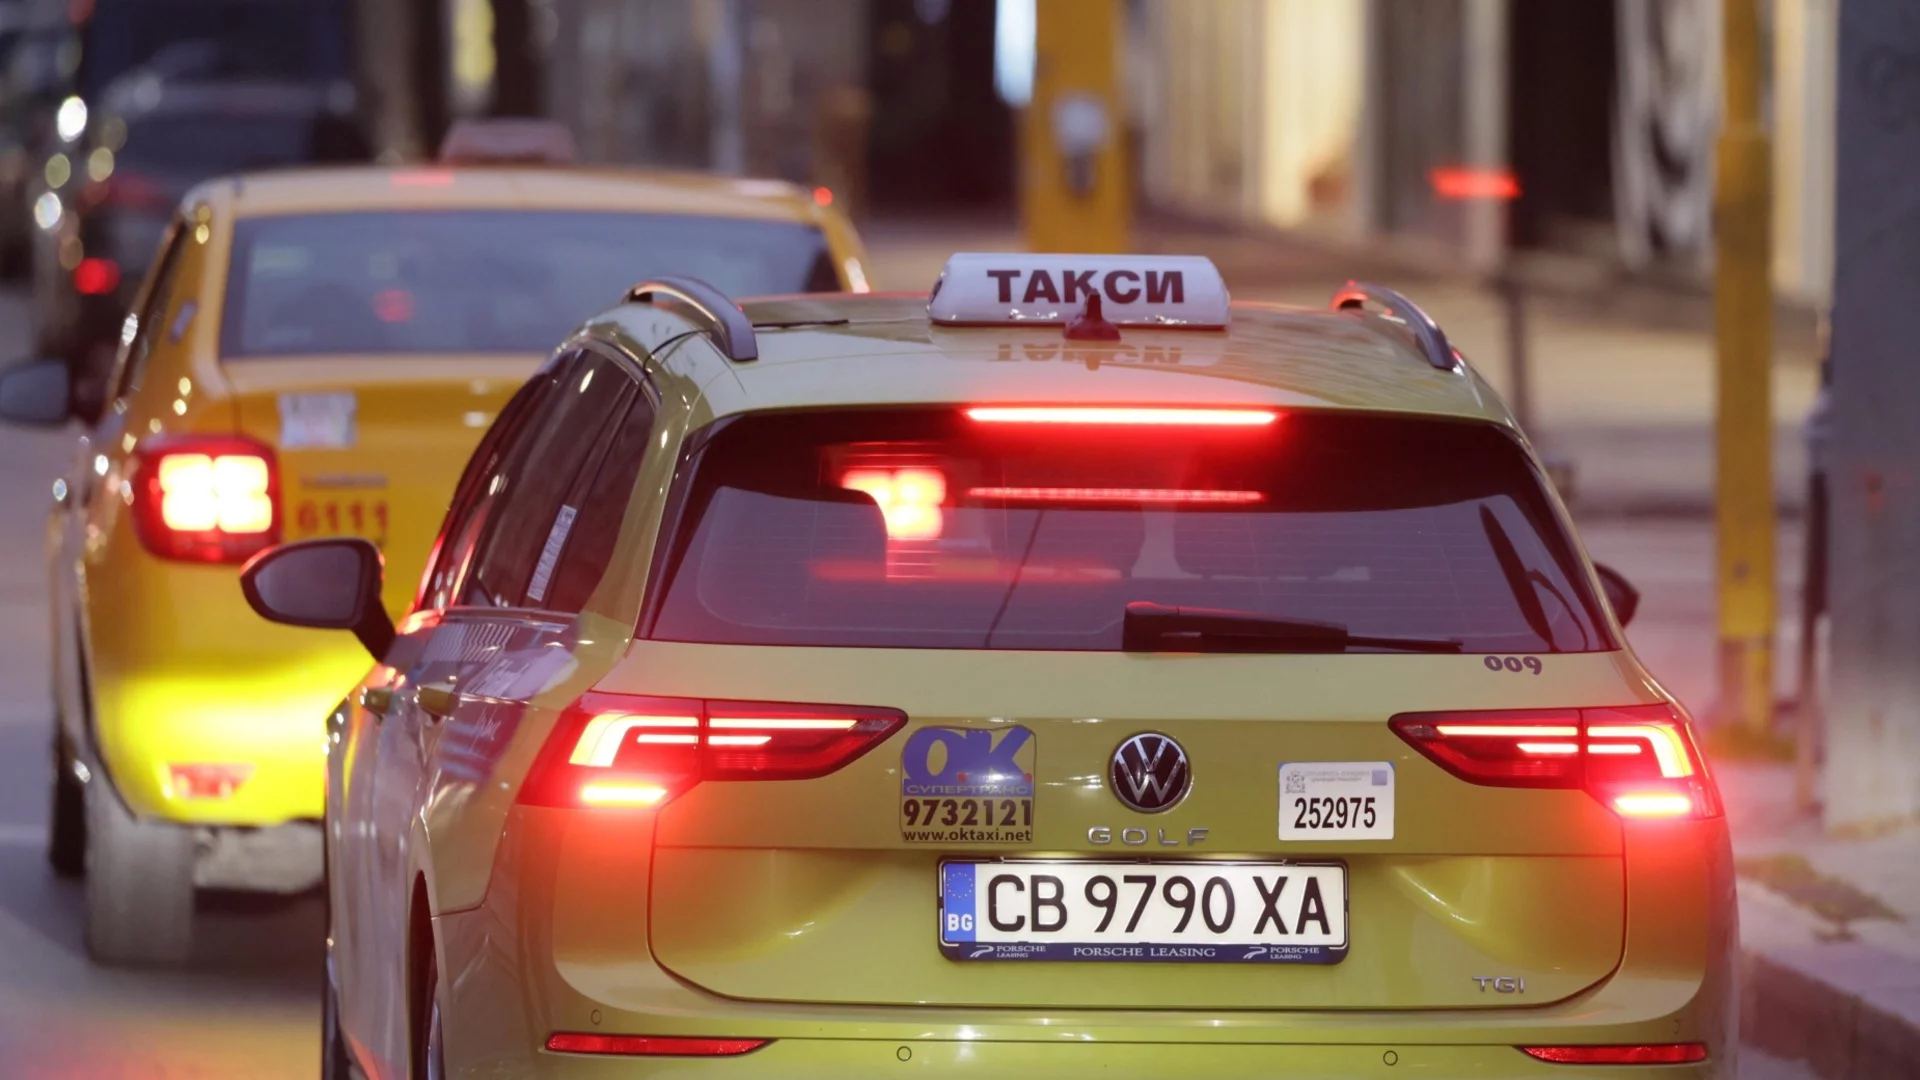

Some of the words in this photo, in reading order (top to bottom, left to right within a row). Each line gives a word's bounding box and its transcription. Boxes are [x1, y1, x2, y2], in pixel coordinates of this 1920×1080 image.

[987, 270, 1185, 304] ТАКСИ
[1483, 655, 1542, 675] 009
[906, 784, 1029, 795] СУПЕРТРАНС
[903, 799, 1032, 826] 9732121
[1294, 797, 1376, 828] 252975
[903, 828, 1032, 841] www.oktaxi.net
[1088, 826, 1210, 845] GOLF
[988, 874, 1068, 932] CB
[1084, 875, 1235, 934] 9790
[1252, 876, 1331, 935] XA
[947, 913, 973, 932] BG
[996, 945, 1046, 953] PORSCHE
[1073, 947, 1144, 957] PORSCHE
[1150, 948, 1216, 958] LEASING
[1270, 946, 1320, 954] PORSCHE
[1472, 976, 1524, 993] TGI
